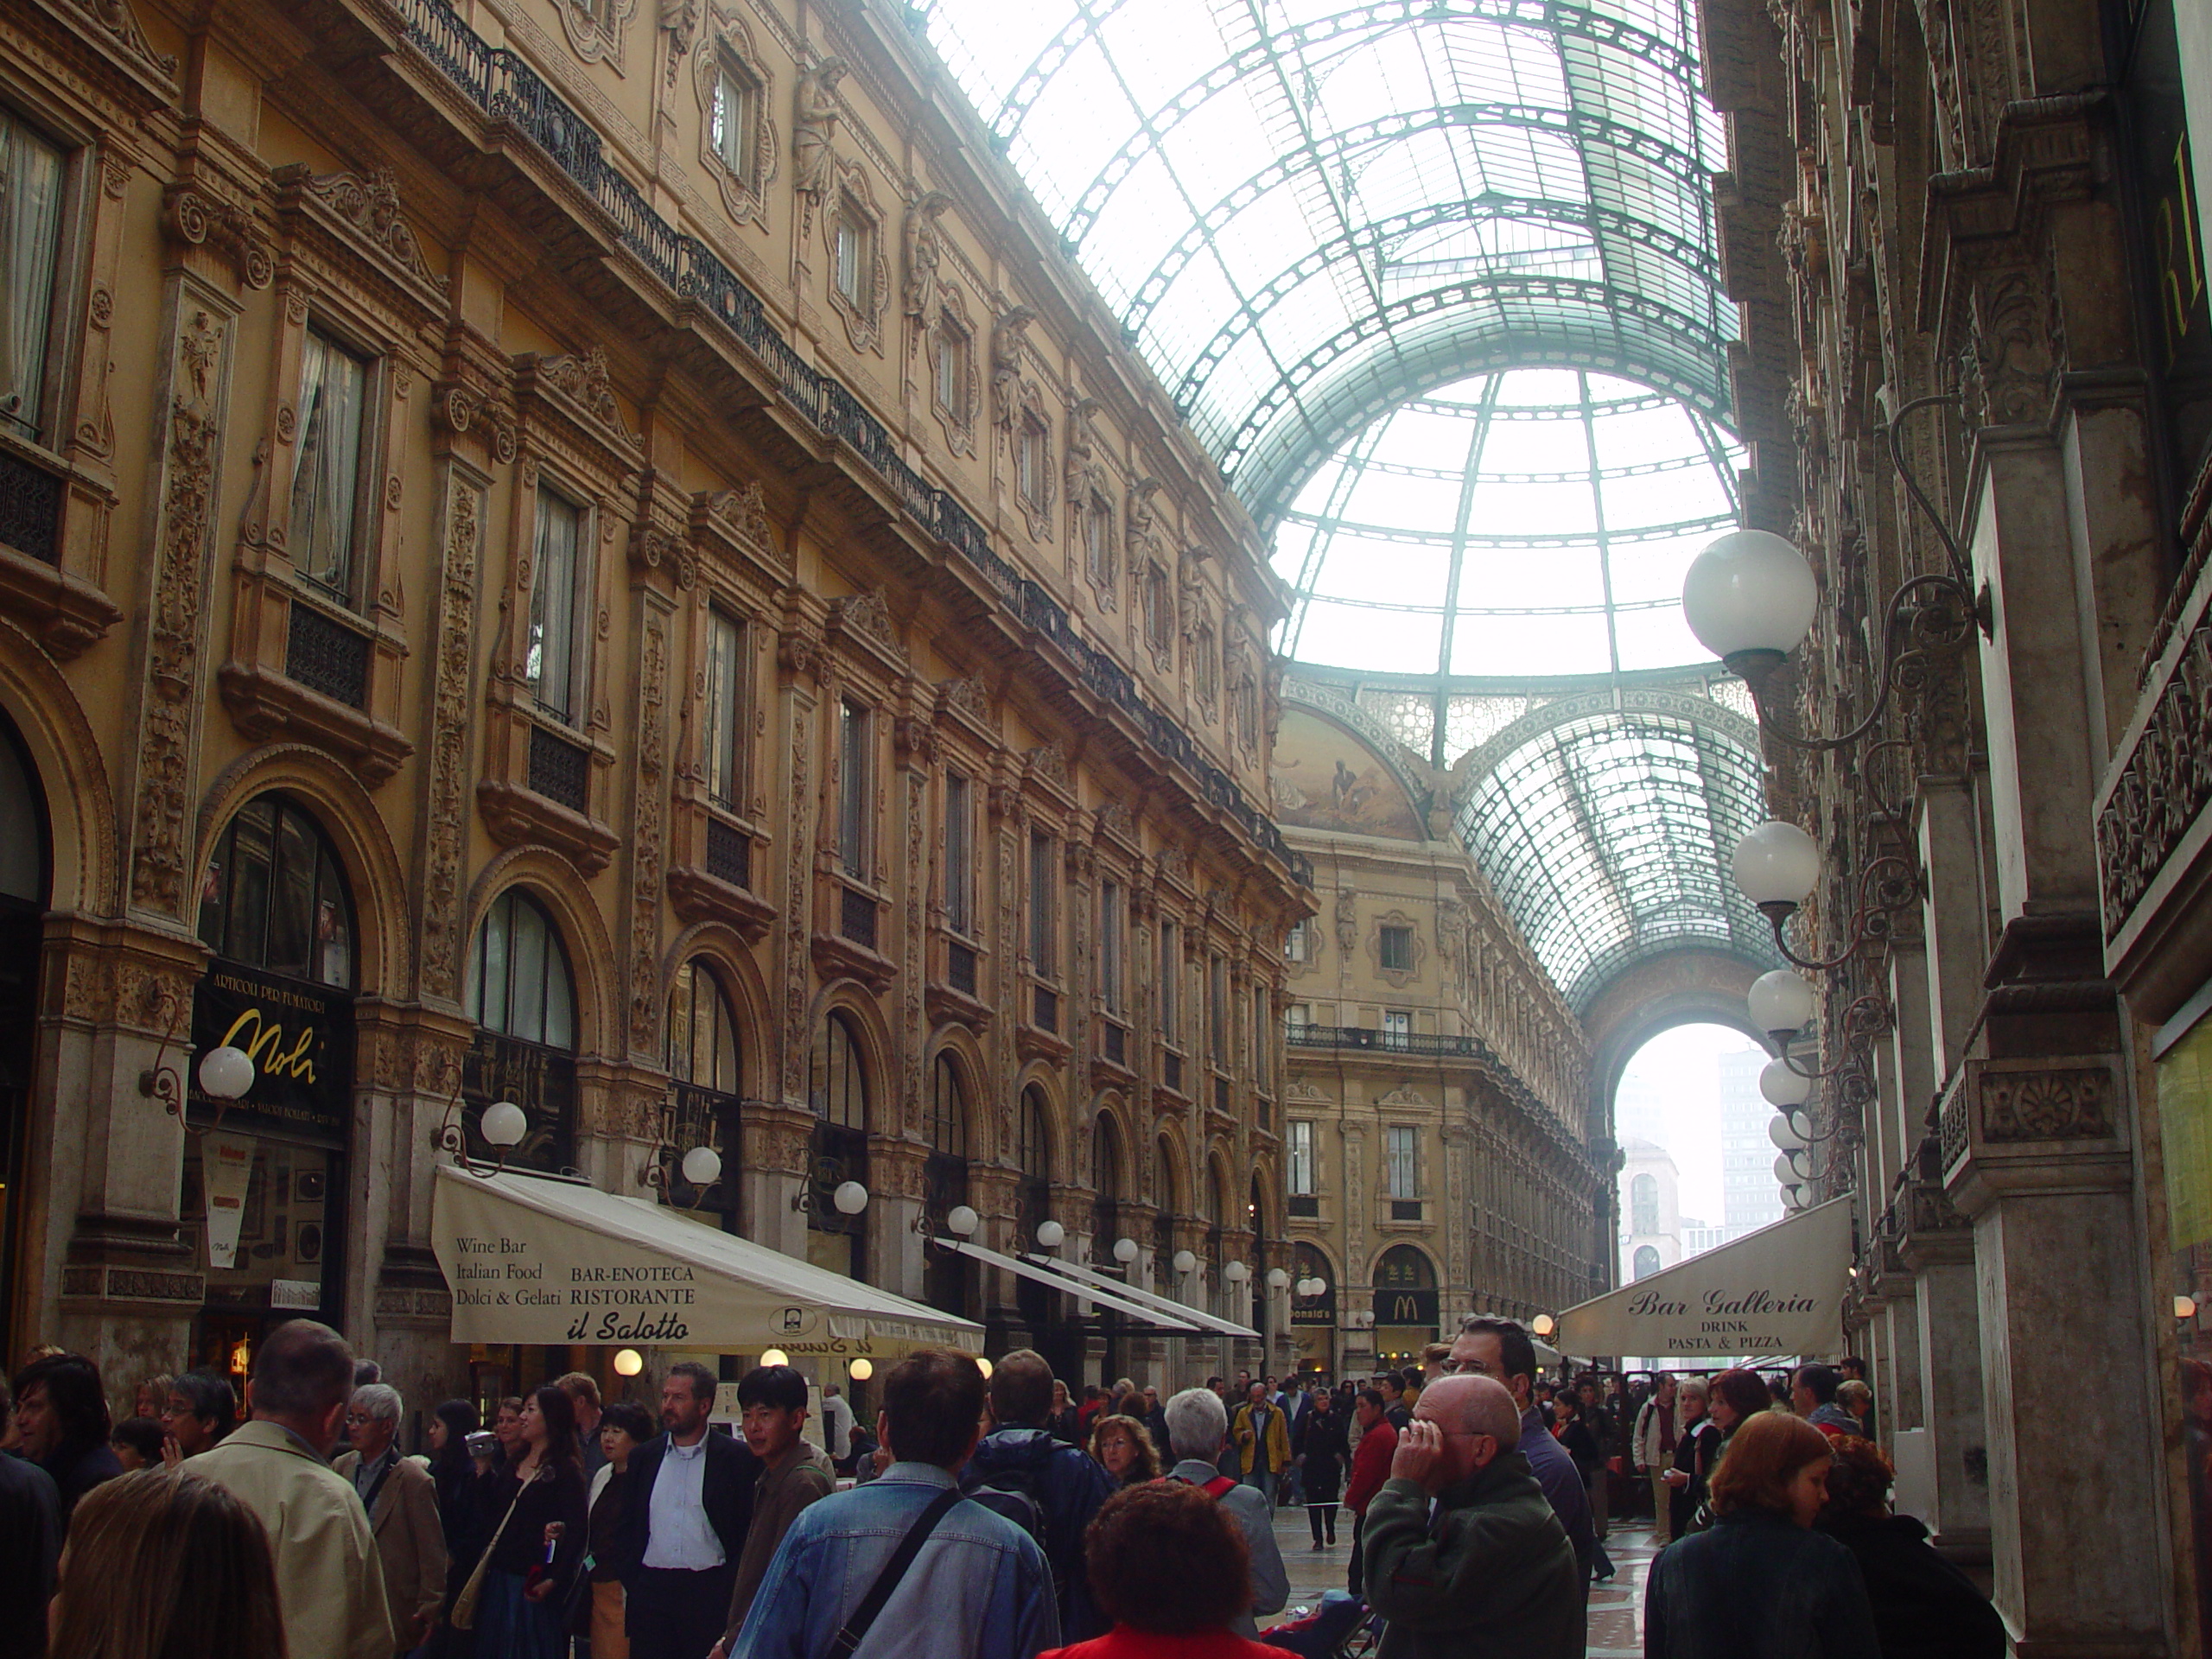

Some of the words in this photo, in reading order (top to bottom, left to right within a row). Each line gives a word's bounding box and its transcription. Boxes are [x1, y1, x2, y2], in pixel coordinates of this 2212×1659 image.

[214, 973, 257, 996] ARTICOLI
[261, 985, 280, 1002] PER
[283, 991, 325, 1014] FUMATORI
[456, 1237, 495, 1254] Wine
[500, 1237, 526, 1254] Bar
[456, 1263, 500, 1280] Italian
[506, 1263, 543, 1280] Food
[571, 1267, 695, 1282] BAR-ENOTECA
[456, 1289, 492, 1306] Dolci
[496, 1291, 510, 1306] &
[515, 1289, 562, 1306] Gelati
[570, 1288, 695, 1305] RISTORANTE
[1628, 1289, 1688, 1315] Bar
[1703, 1289, 1819, 1314] Galleria
[567, 1312, 589, 1339] il
[597, 1311, 690, 1339] Salotto
[1701, 1321, 1748, 1332] DRINK
[1668, 1338, 1711, 1350] PASTA
[1718, 1337, 1731, 1349] &
[1740, 1337, 1783, 1348] PIZZA
